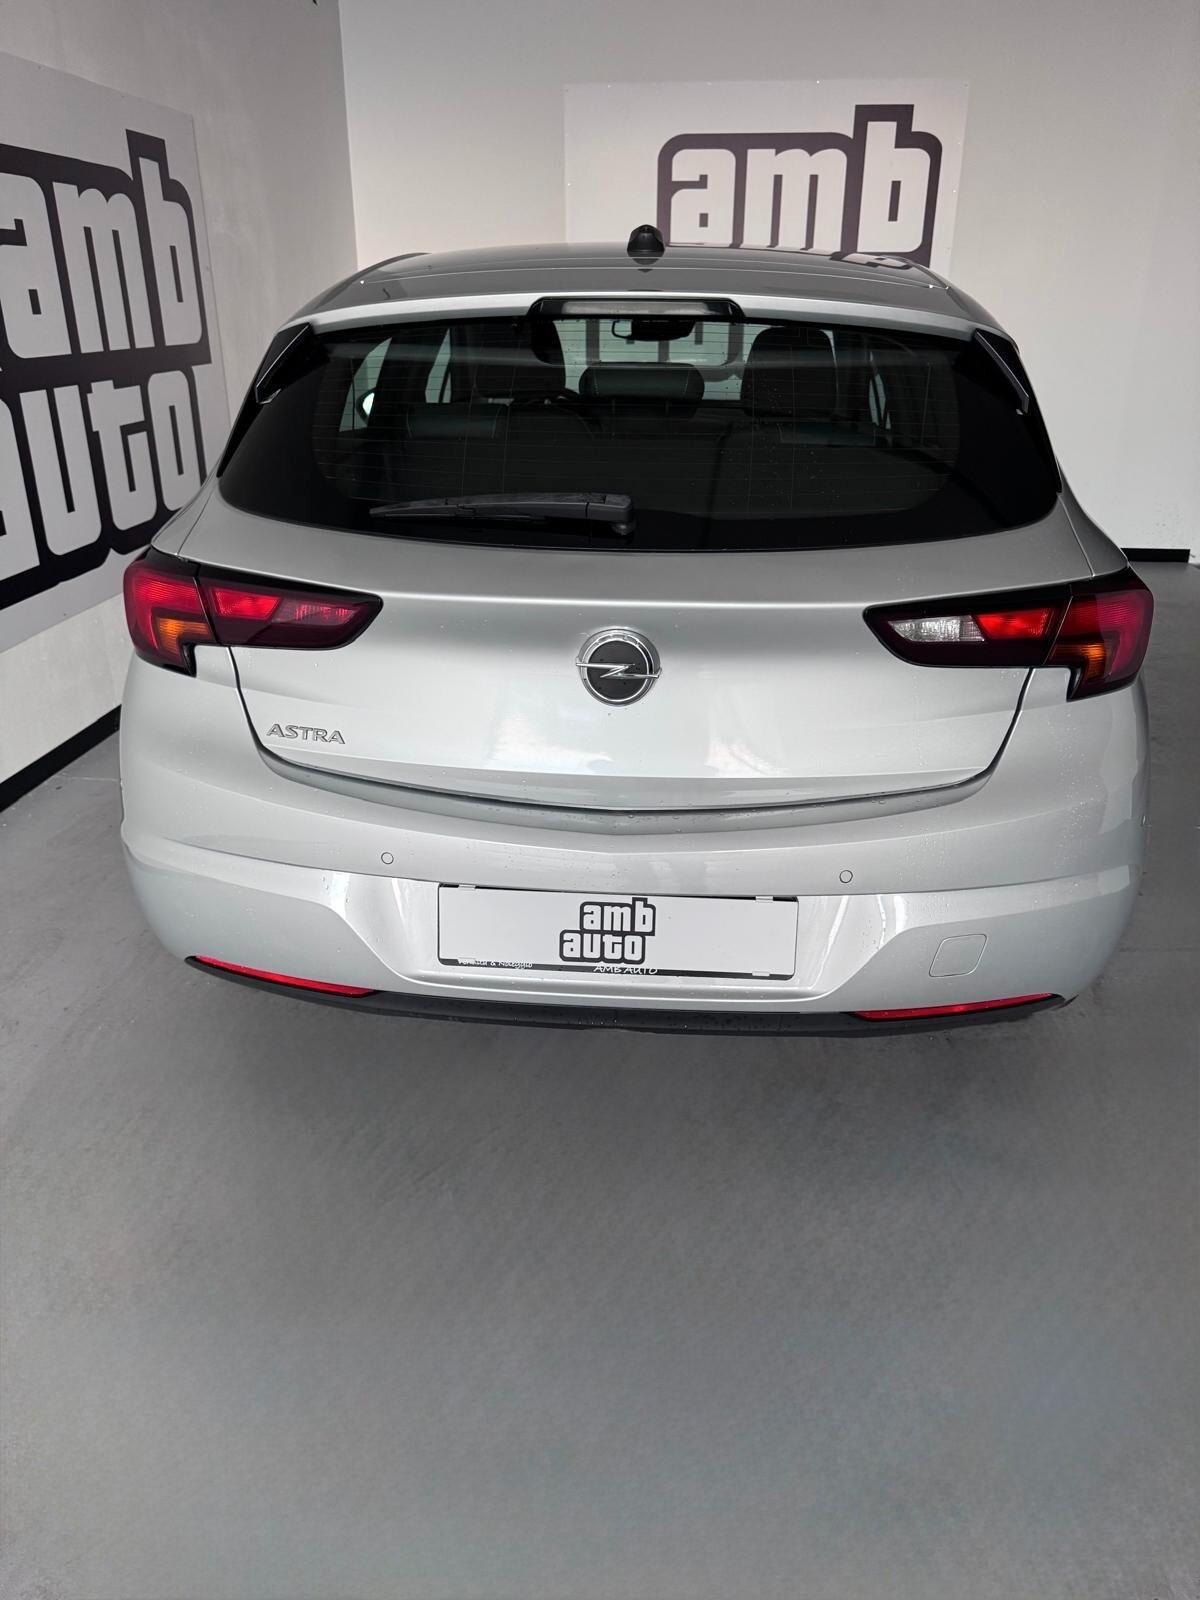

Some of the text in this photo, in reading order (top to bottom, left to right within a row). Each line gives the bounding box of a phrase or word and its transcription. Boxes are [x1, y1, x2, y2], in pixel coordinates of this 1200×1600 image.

[669, 120, 931, 253] amb
[0, 156, 202, 359] amb
[266, 723, 346, 745] ASTRA
[582, 900, 654, 933] amb
[562, 932, 643, 961] auto
